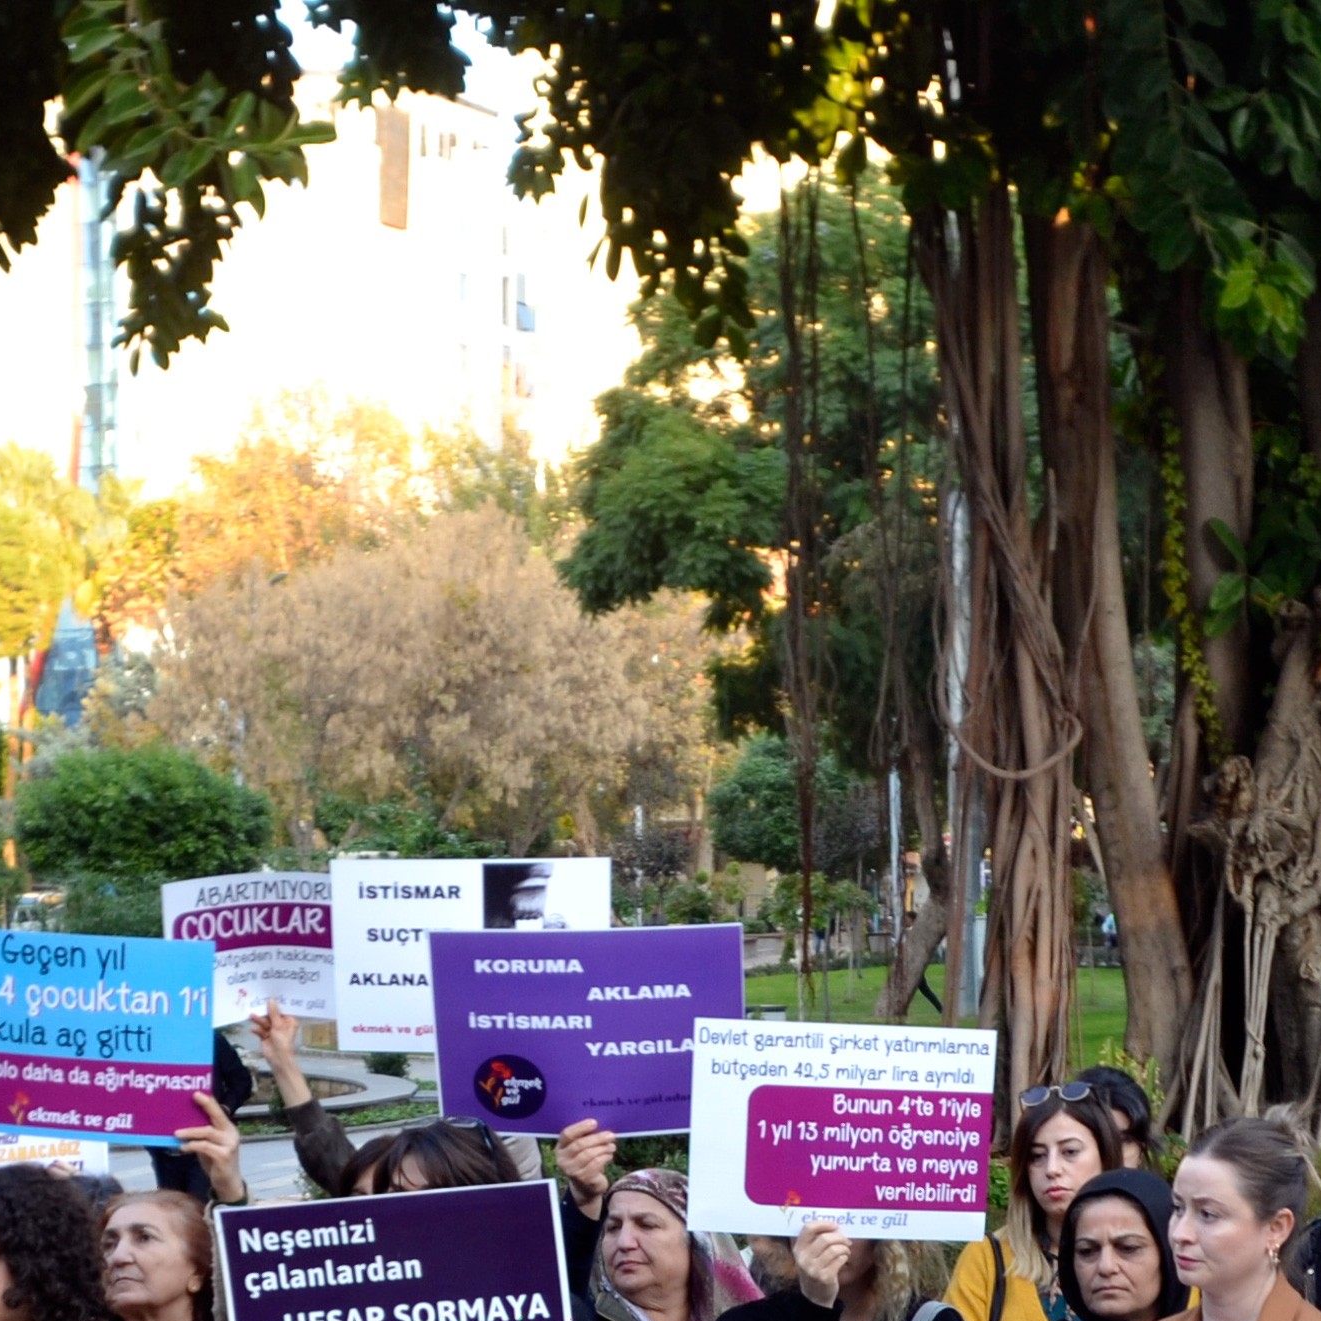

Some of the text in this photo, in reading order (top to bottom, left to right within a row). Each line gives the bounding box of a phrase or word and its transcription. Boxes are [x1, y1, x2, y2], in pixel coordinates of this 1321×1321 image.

[195, 879, 332, 907] ABARTMIYOR
[358, 881, 461, 900] İSTİSMAR
[367, 927, 427, 946] SUÇT
[1, 933, 127, 981] Geçen yıl
[474, 958, 584, 974] KORUMA
[25, 980, 170, 1017] çocuktan
[178, 986, 209, 1017] 1'i
[586, 983, 692, 1001] AKLAMA
[352, 1024, 434, 1037] ekmek ve gül
[468, 1011, 593, 1030] İSTİSMARI
[56, 1026, 87, 1057] aç
[96, 1024, 153, 1058] gitti
[698, 1026, 990, 1057] Devlet garantili şirket yatırımlarına
[22, 1062, 64, 1084] daha
[68, 1066, 90, 1086] da
[94, 1067, 212, 1094] ağırlaşmasın!
[711, 1059, 974, 1088] bütçeden 42,5 milyar lira ayrıldı
[27, 1107, 133, 1132] ekmek ve gül
[833, 1094, 982, 1122] Bunun 4'te 1'iyle
[758, 1120, 980, 1151] 1 yıl 13 milyon öğrenciye
[810, 1153, 979, 1180] yumurta ve meyve
[874, 1183, 977, 1203] verilebilirdi
[860, 1215, 879, 1226] ve
[882, 1213, 909, 1229] gül
[238, 1218, 376, 1256] Neşemizi
[244, 1255, 423, 1298] çalanlardan
